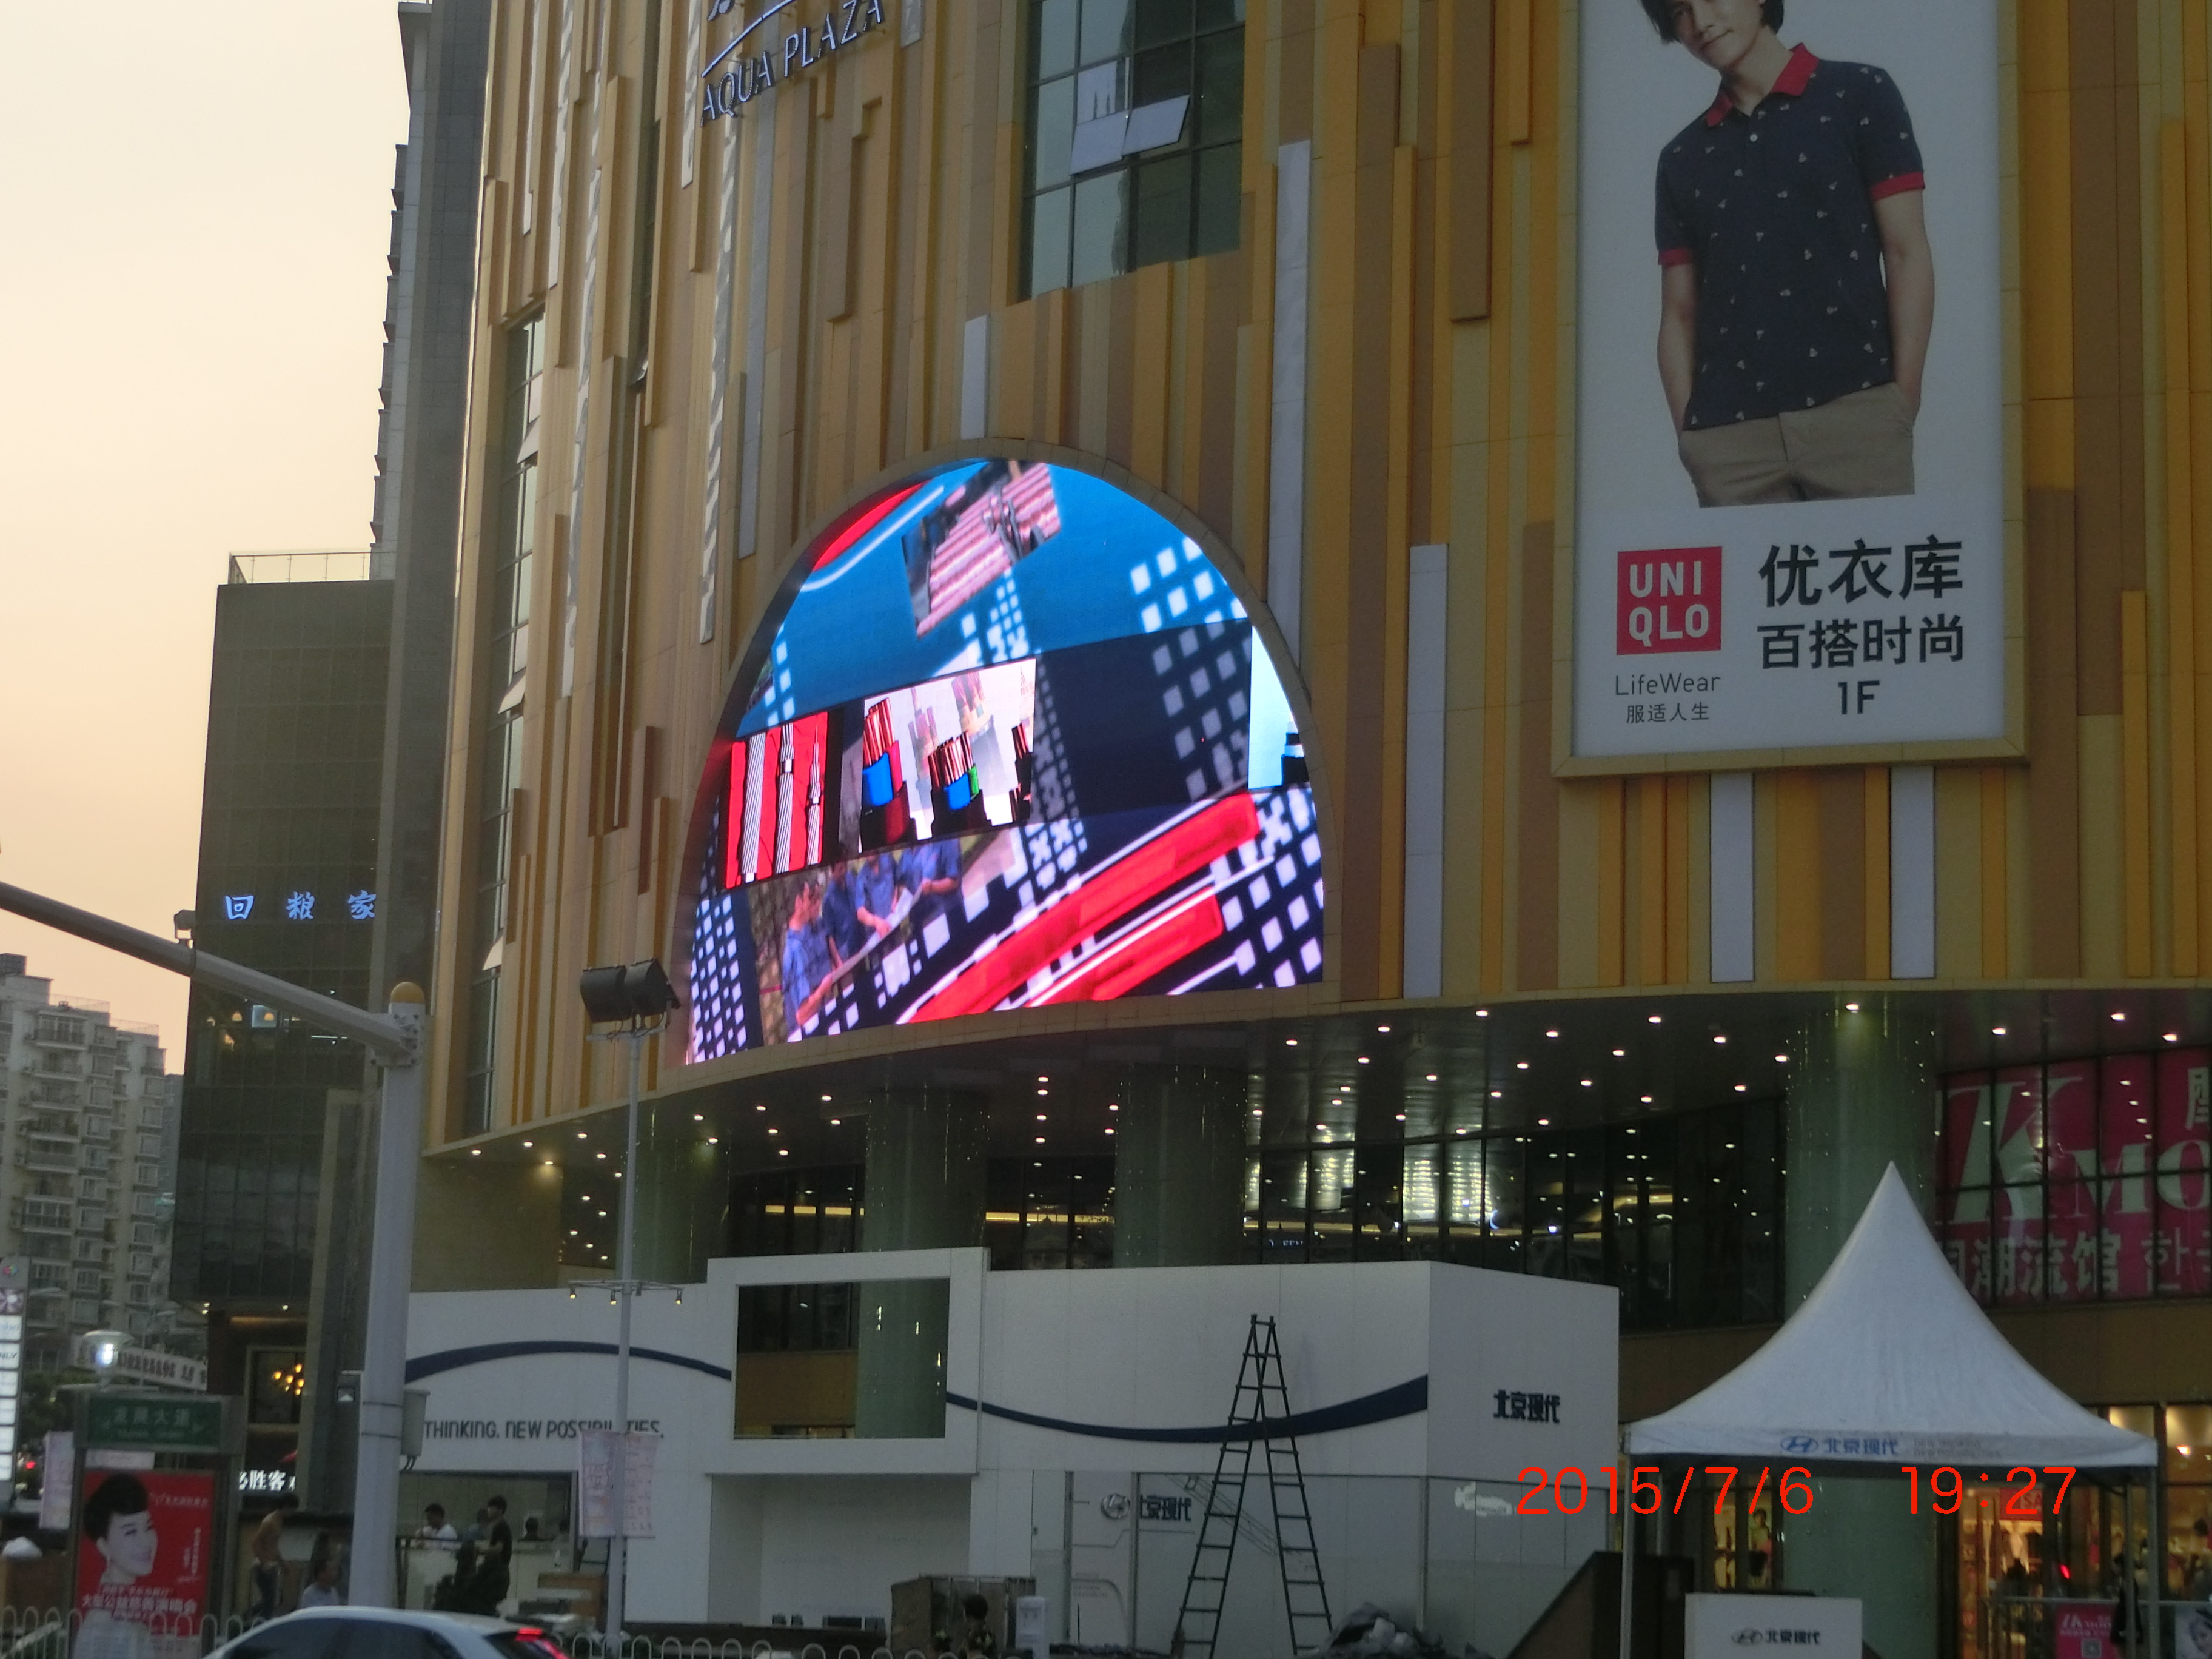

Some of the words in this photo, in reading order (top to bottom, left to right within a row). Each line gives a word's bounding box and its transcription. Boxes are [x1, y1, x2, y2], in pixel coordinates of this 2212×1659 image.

[699, 50, 774, 128] AQUA
[783, 0, 883, 78] PLAZA
[1629, 560, 1702, 598] UNI
[1758, 534, 1963, 608] 优衣库
[1629, 603, 1709, 647] QLO
[1757, 613, 1963, 669] 百搭时尚
[1615, 672, 1721, 695] LifeWear
[1838, 680, 1880, 715] 1F
[1626, 701, 1709, 724] 服适人生
[1493, 1389, 1561, 1423] 北京现代
[506, 1420, 542, 1439] NEW
[1825, 1438, 1899, 1455] 北京现代
[238, 1469, 286, 1491] 必胜客
[1765, 1628, 1821, 1645] 北京现代
